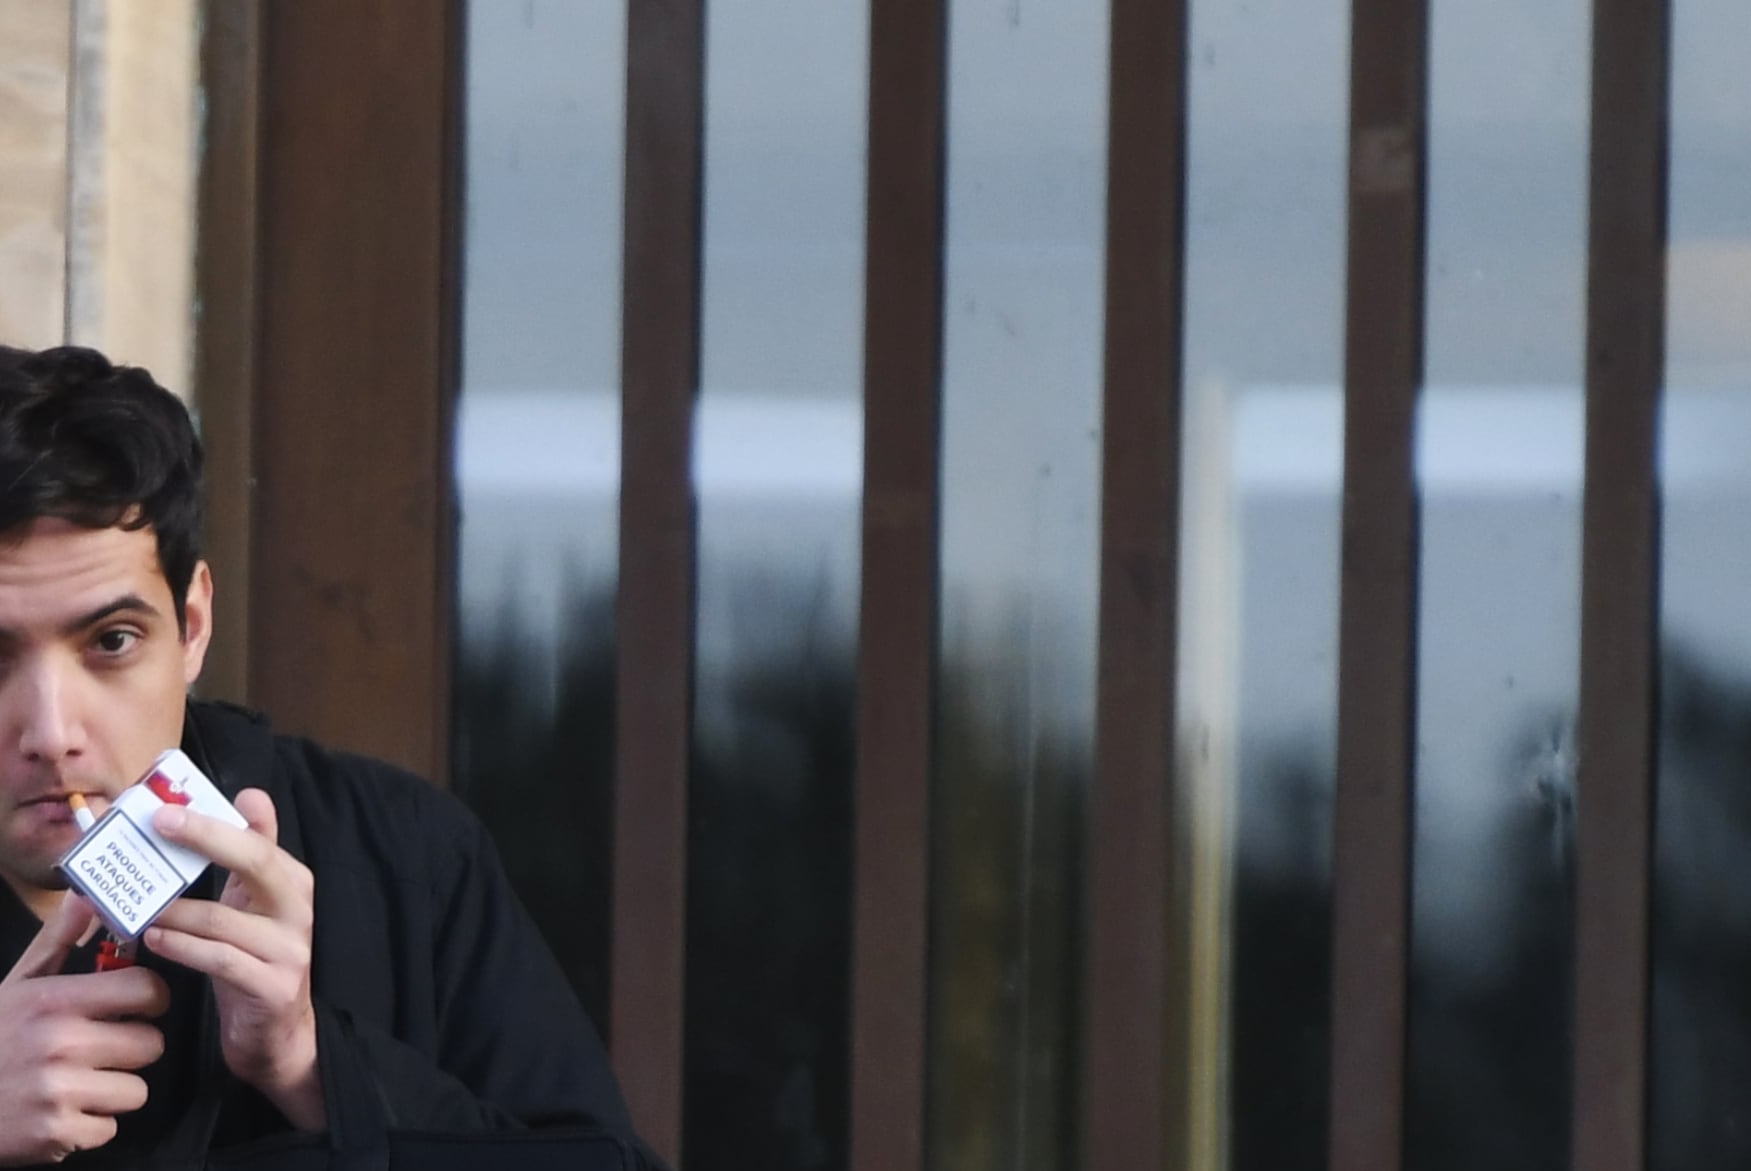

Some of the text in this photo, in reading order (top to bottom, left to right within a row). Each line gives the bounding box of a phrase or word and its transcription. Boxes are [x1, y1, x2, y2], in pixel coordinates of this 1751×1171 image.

[80, 860, 138, 922] CARDÍACOS
[97, 855, 146, 904] ATAQUES
[107, 841, 156, 895] PRODUCE
